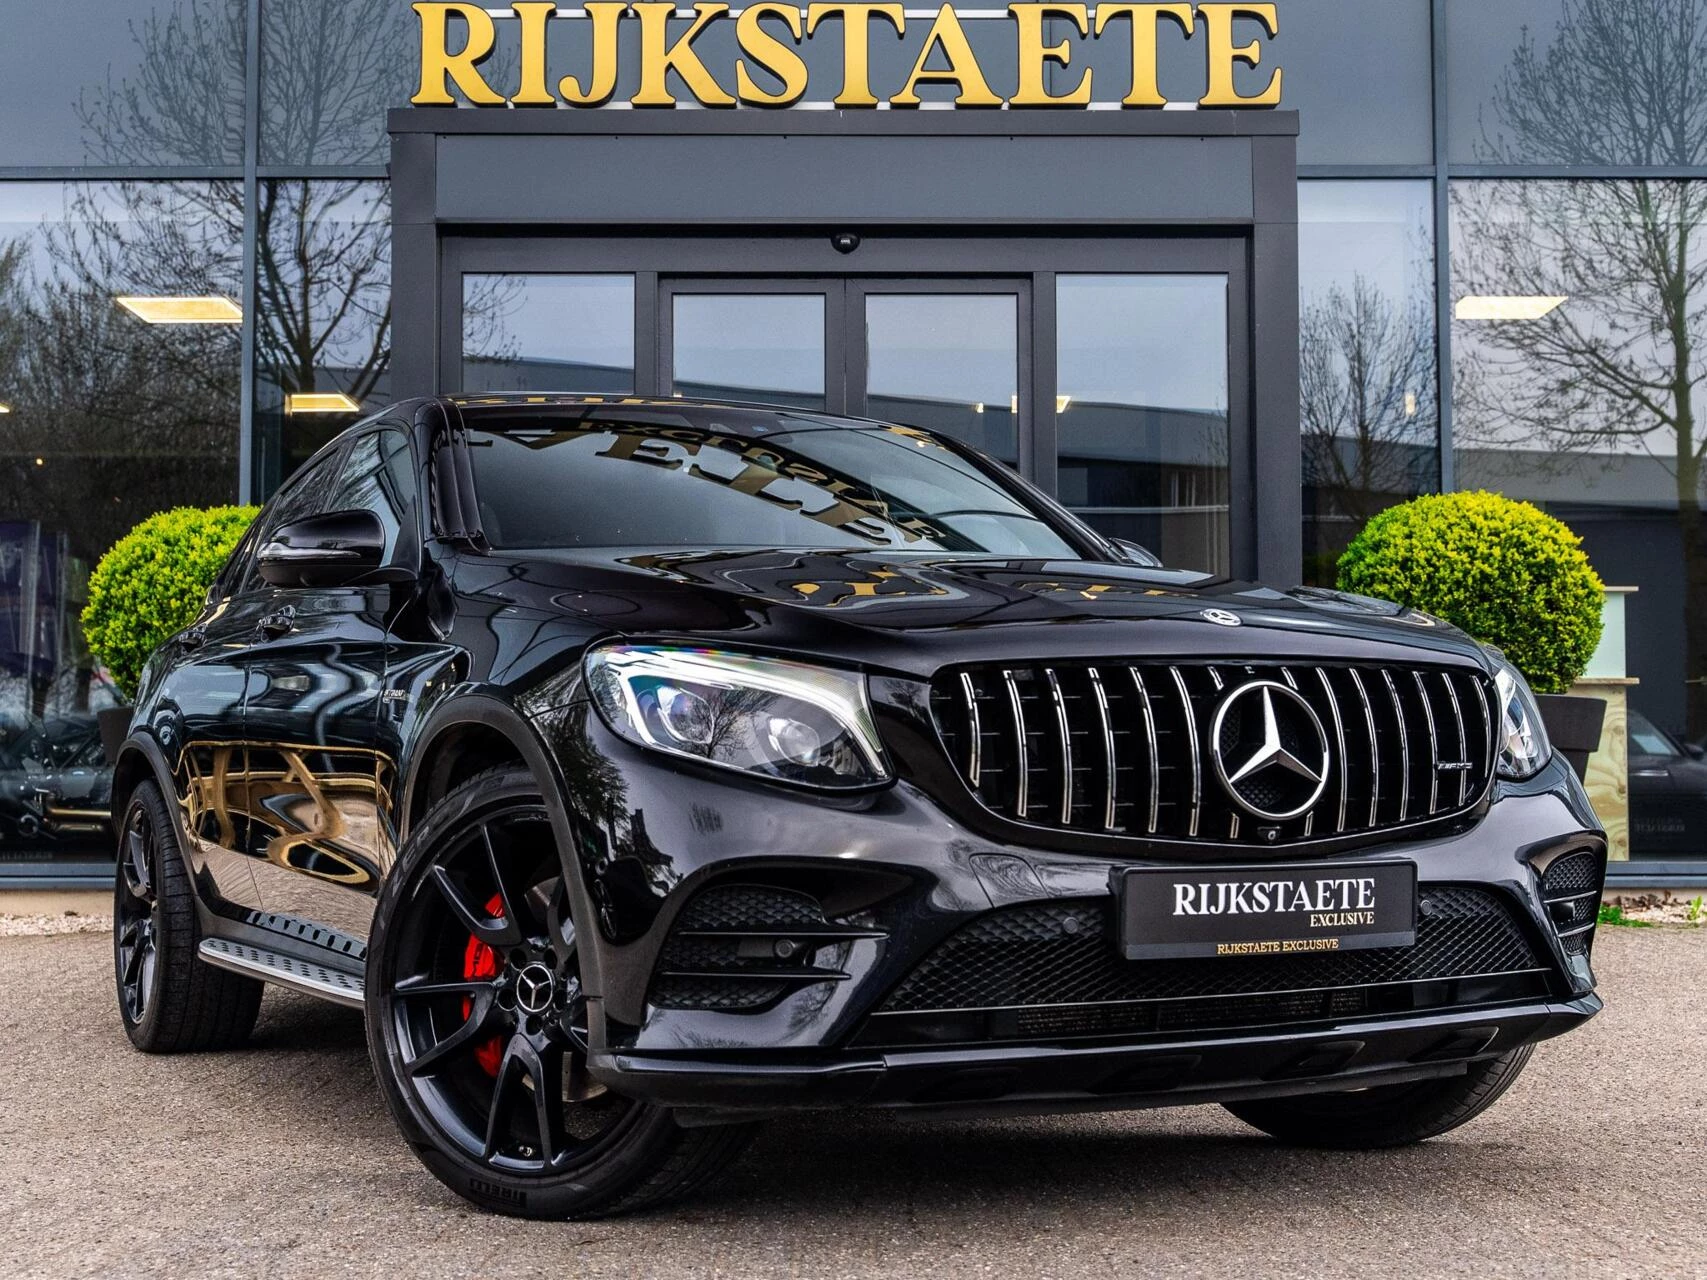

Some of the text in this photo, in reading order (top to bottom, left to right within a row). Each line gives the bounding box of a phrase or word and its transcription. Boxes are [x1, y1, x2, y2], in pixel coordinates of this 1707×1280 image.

[409, 1, 1283, 109] RIJKSTAETE
[1173, 878, 1376, 916] RIJKSTAETE
[1310, 911, 1375, 928] EXCLUSIVE
[1216, 938, 1340, 956] RIJKSTAETE EXCLUSIVE
